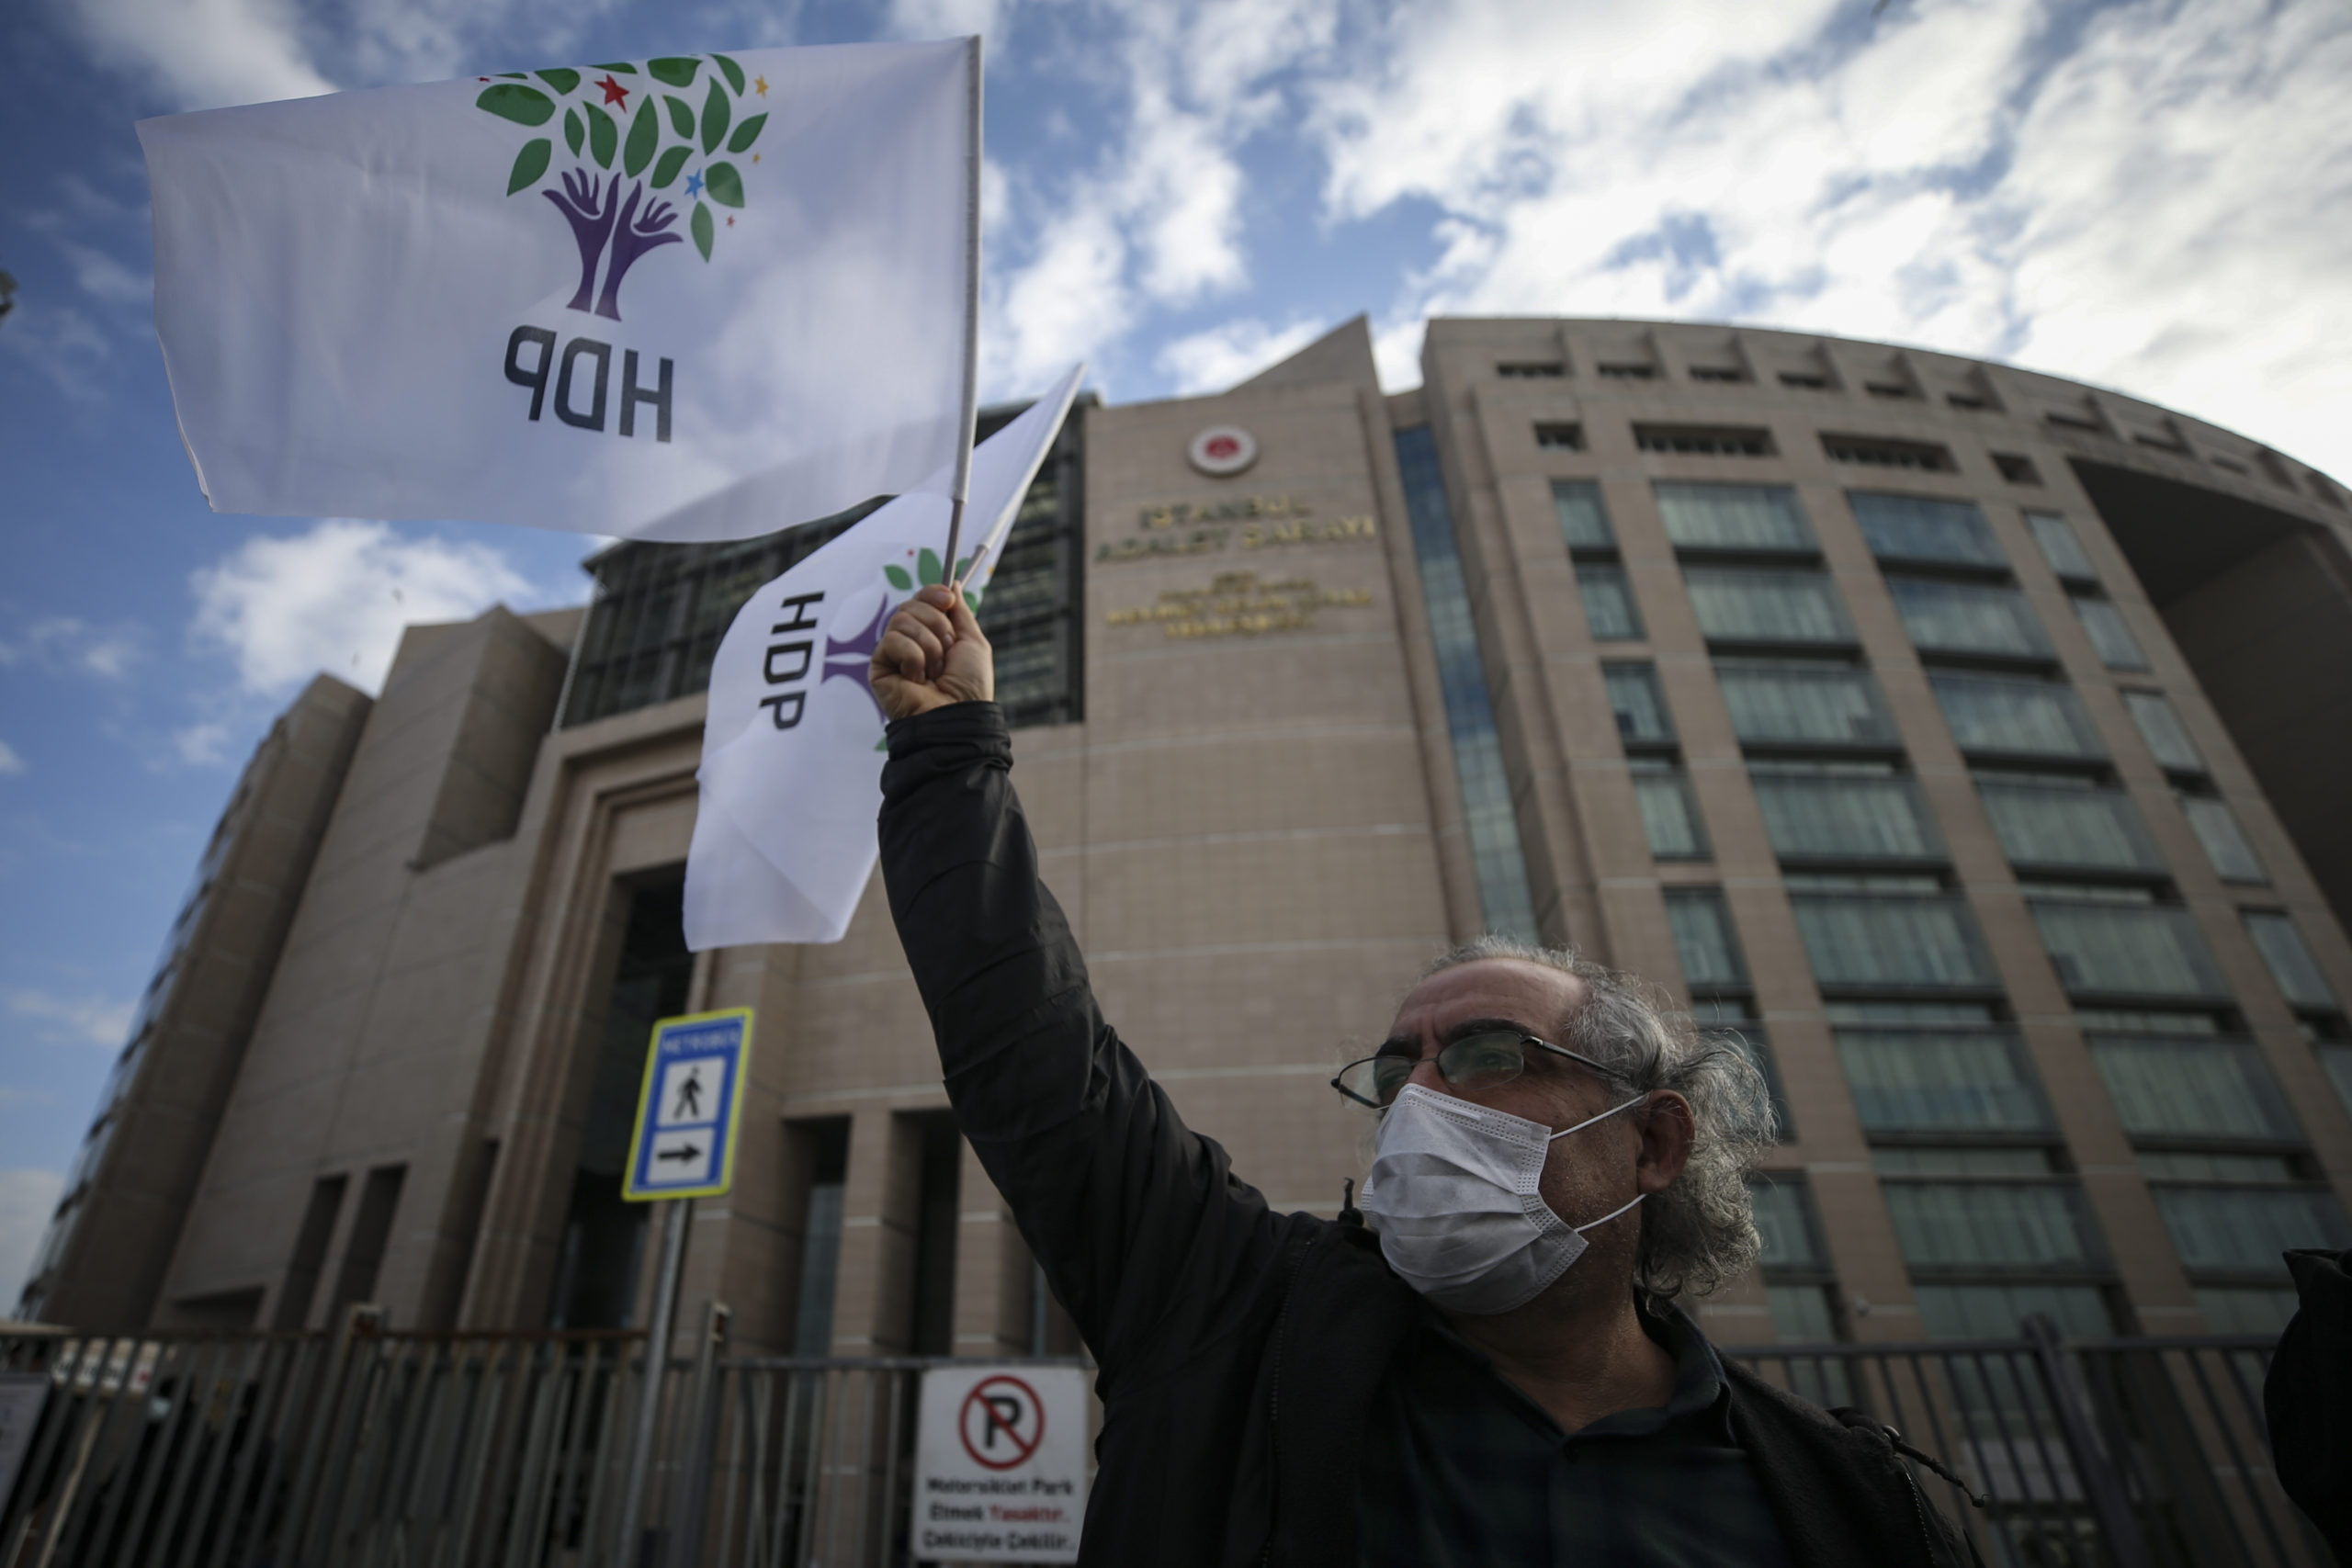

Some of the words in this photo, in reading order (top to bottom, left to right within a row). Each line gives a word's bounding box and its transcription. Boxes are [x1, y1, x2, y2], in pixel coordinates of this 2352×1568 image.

[760, 591, 825, 731] HDP
[1032, 1477, 1074, 1495] Park
[929, 1502, 984, 1521] Etmek
